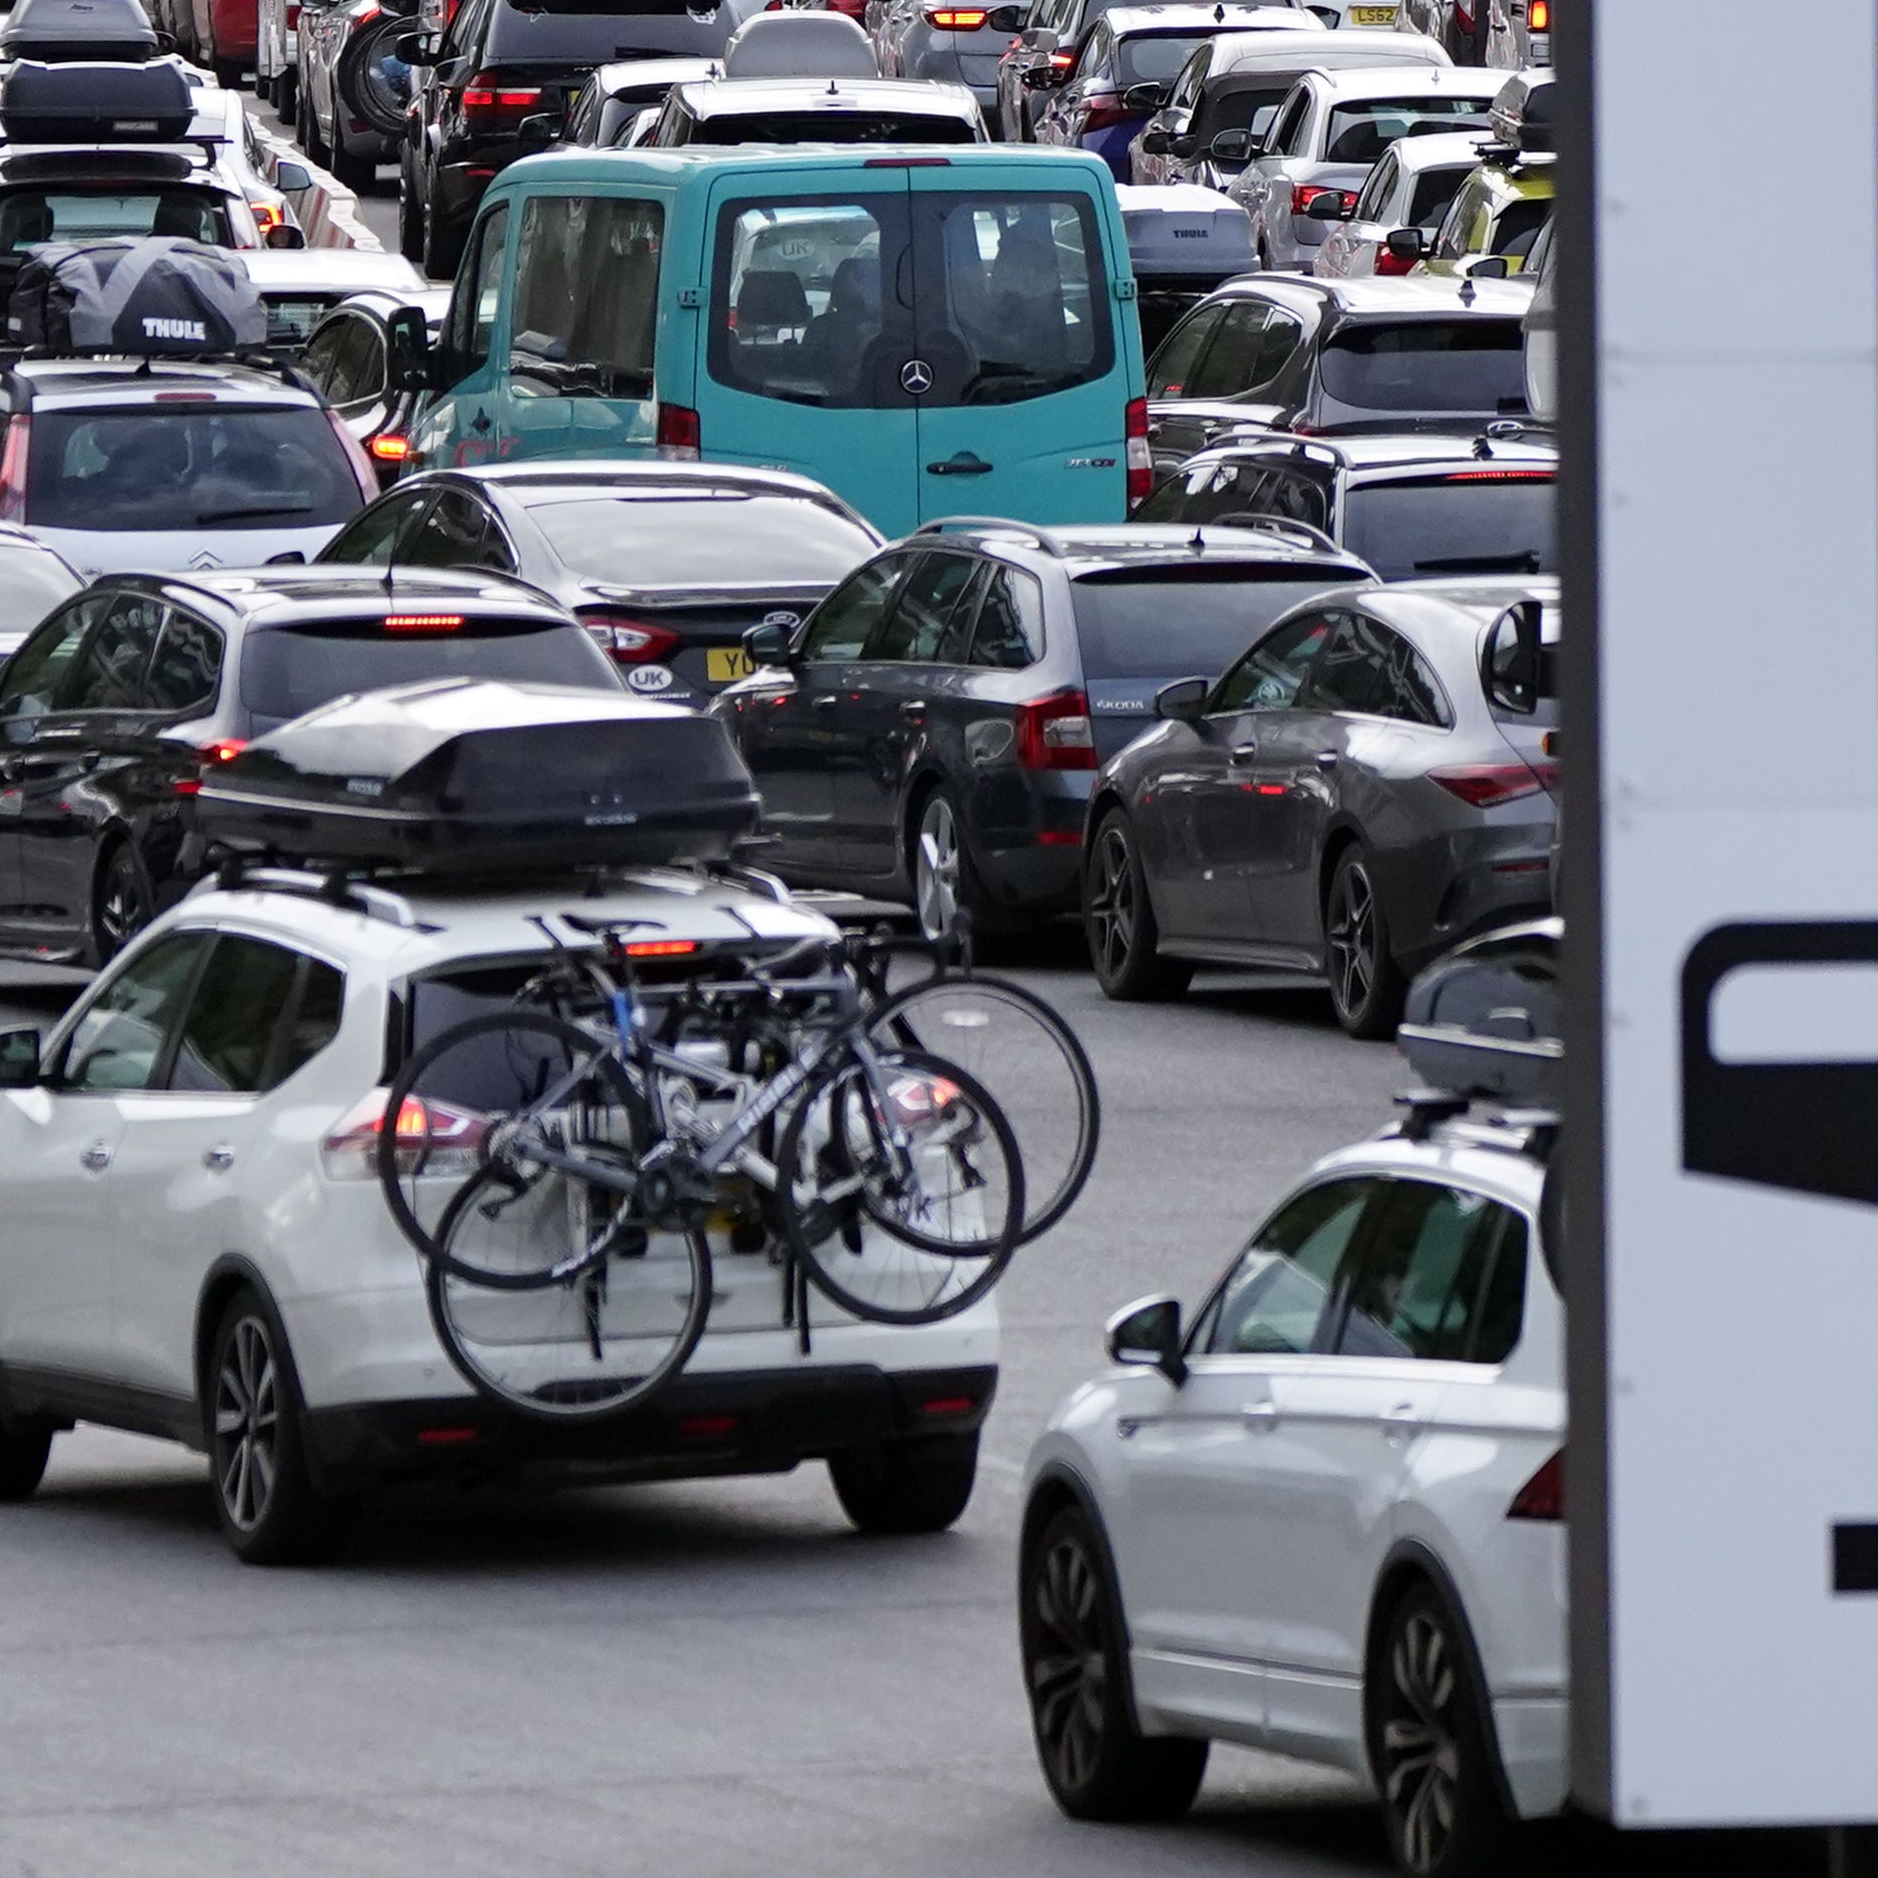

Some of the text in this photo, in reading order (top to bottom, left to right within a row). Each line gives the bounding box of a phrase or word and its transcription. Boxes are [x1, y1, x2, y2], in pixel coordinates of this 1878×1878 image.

[1357, 8, 1394, 22] LS62
[781, 241, 811, 258] UK
[142, 317, 206, 340] THULE
[633, 671, 664, 686] UK
